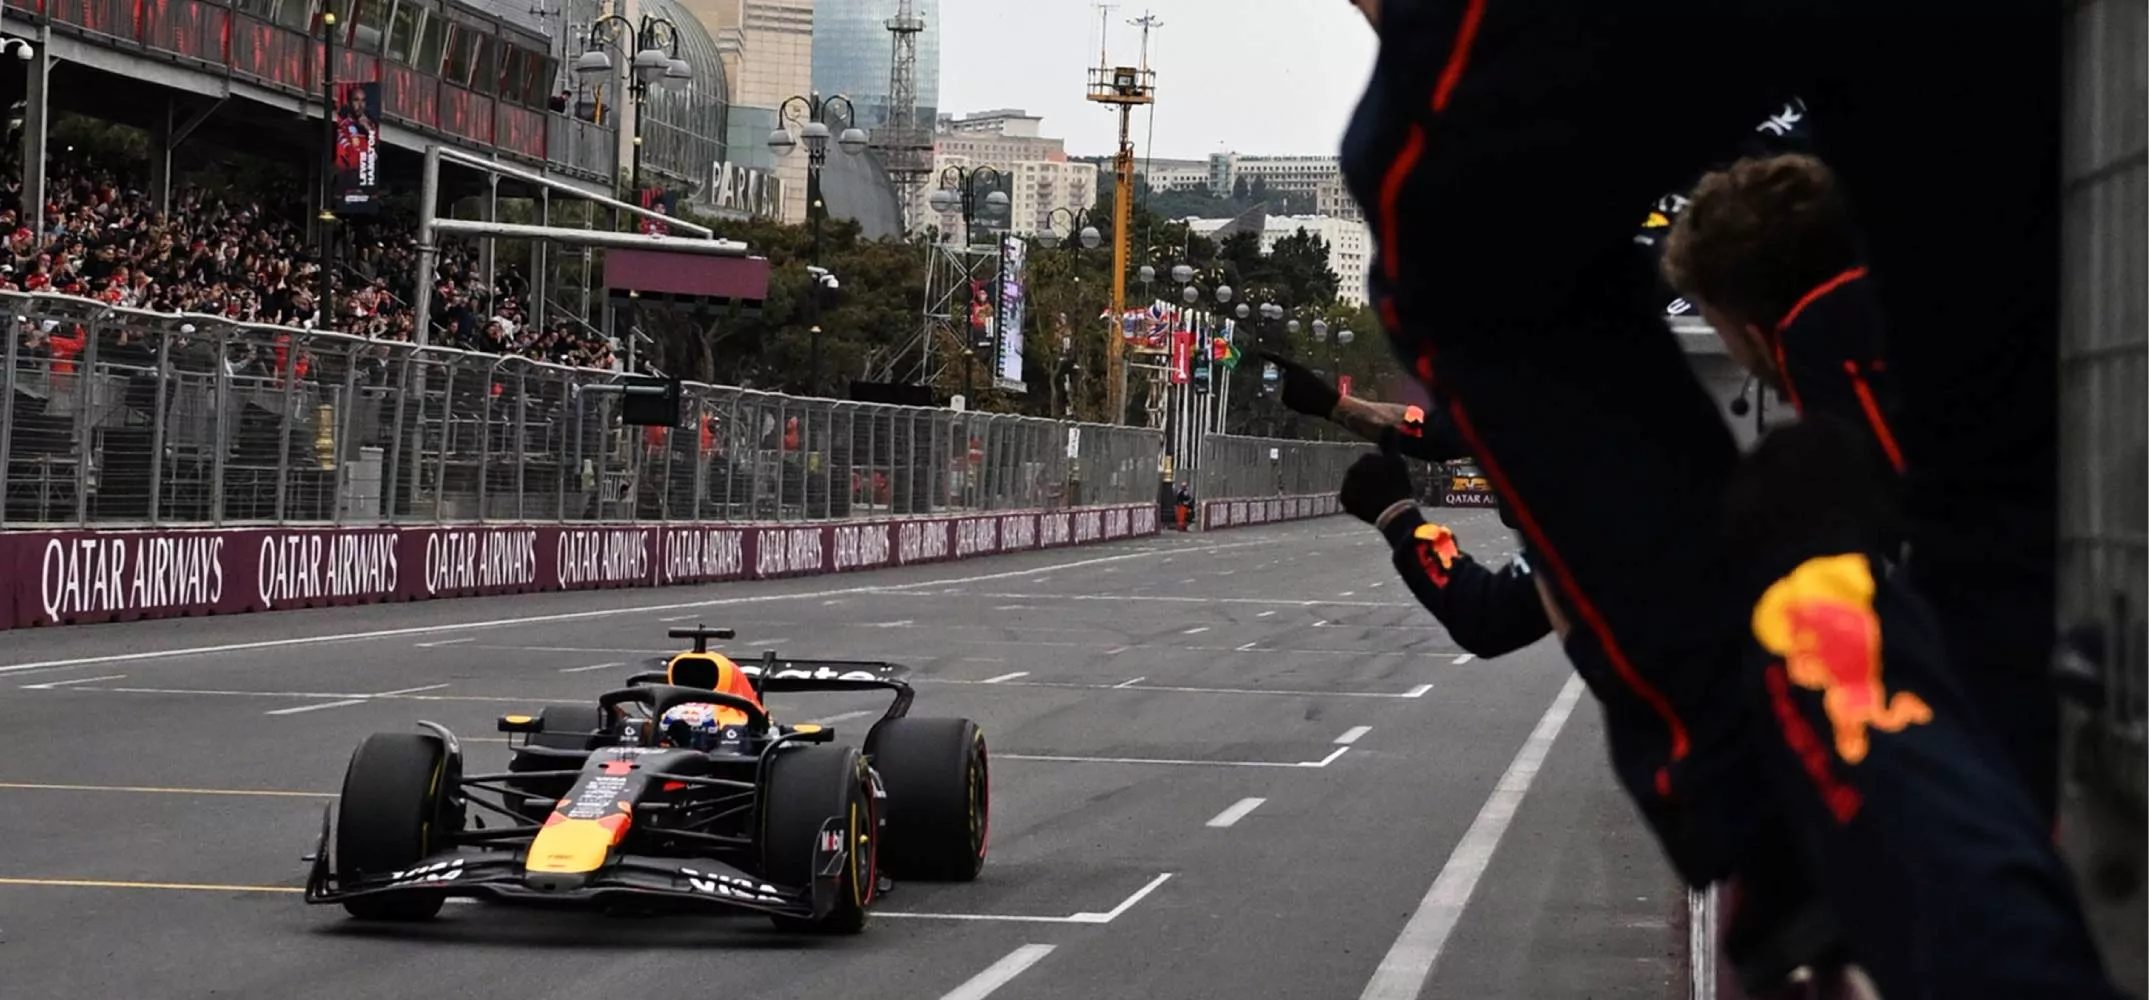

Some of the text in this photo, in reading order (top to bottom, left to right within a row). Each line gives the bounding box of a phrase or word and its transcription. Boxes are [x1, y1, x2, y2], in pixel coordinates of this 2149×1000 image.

[711, 160, 757, 214] PARK
[1445, 494, 1481, 504] QATAR
[41, 536, 224, 622] QATAR AIRWAYS
[258, 533, 399, 608] QATAR AIRWAYS
[425, 529, 536, 594] QATAR AIRWAYS
[557, 529, 648, 589] QATAR AIRWAYS
[665, 529, 743, 583] QATAR AIRWAYS
[681, 867, 787, 904] VISA
